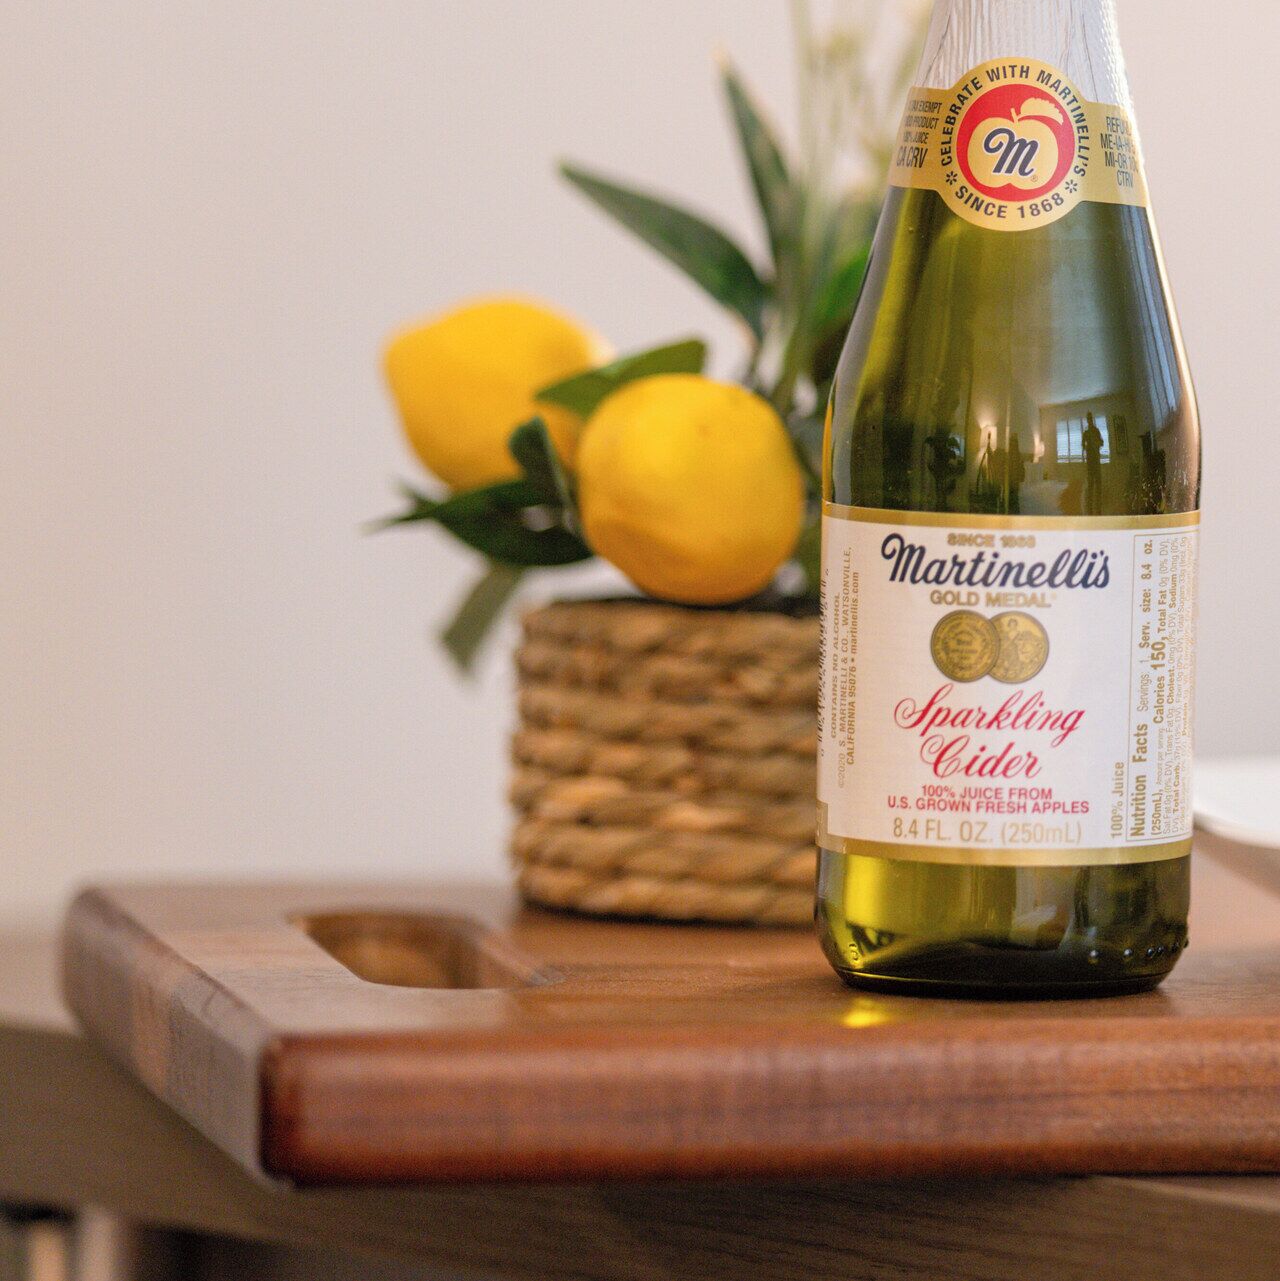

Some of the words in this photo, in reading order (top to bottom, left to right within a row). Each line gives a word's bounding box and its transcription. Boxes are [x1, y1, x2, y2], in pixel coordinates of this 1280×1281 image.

[941, 77, 982, 166] CELEBRATE
[987, 64, 1029, 82] WITH
[1037, 70, 1090, 177] MARTINELLI'S
[907, 147, 928, 168] CRV
[955, 185, 1008, 218] SINCE
[1018, 193, 1064, 218] 1868
[881, 533, 1110, 589] Martinelli's
[1144, 540, 1152, 555] oz.
[842, 546, 852, 626] WATSONVILLE,
[1141, 564, 1152, 580] 8.4
[931, 590, 979, 606] GOLD
[986, 592, 1052, 607] MEDAL
[1140, 588, 1151, 613] size:
[1158, 590, 1166, 605] Fat
[1169, 574, 1177, 608] Sodium
[850, 572, 859, 654] martinellis.com
[1158, 609, 1166, 633] Total
[1139, 622, 1150, 648] Serv.
[832, 654, 838, 671] NO
[840, 656, 847, 664] &
[1151, 636, 1169, 670] 150,
[848, 666, 856, 697] 95076
[839, 668, 847, 732] MARTINELLI
[894, 683, 1085, 748] Sparkling
[1153, 676, 1165, 724] Calories
[846, 701, 856, 765] CALIFORNIA
[1132, 723, 1148, 763] Facts
[920, 734, 1042, 778] Cider
[922, 785, 955, 799] 100%
[960, 787, 1003, 800] JUICE
[1009, 788, 1052, 800] FROM
[1112, 762, 1124, 797] Juice
[888, 796, 911, 809] U.S.
[916, 798, 971, 812] GROWN
[977, 801, 1026, 814] FRESH
[1032, 801, 1089, 814] APPLES
[1111, 801, 1123, 839] 100%
[1130, 775, 1146, 837] Nutrition
[1151, 789, 1163, 835] (250mL),
[893, 818, 918, 838] 8.4
[926, 820, 949, 840] FL.
[960, 821, 993, 843] OZ.
[1001, 822, 1082, 844] (250mL)
